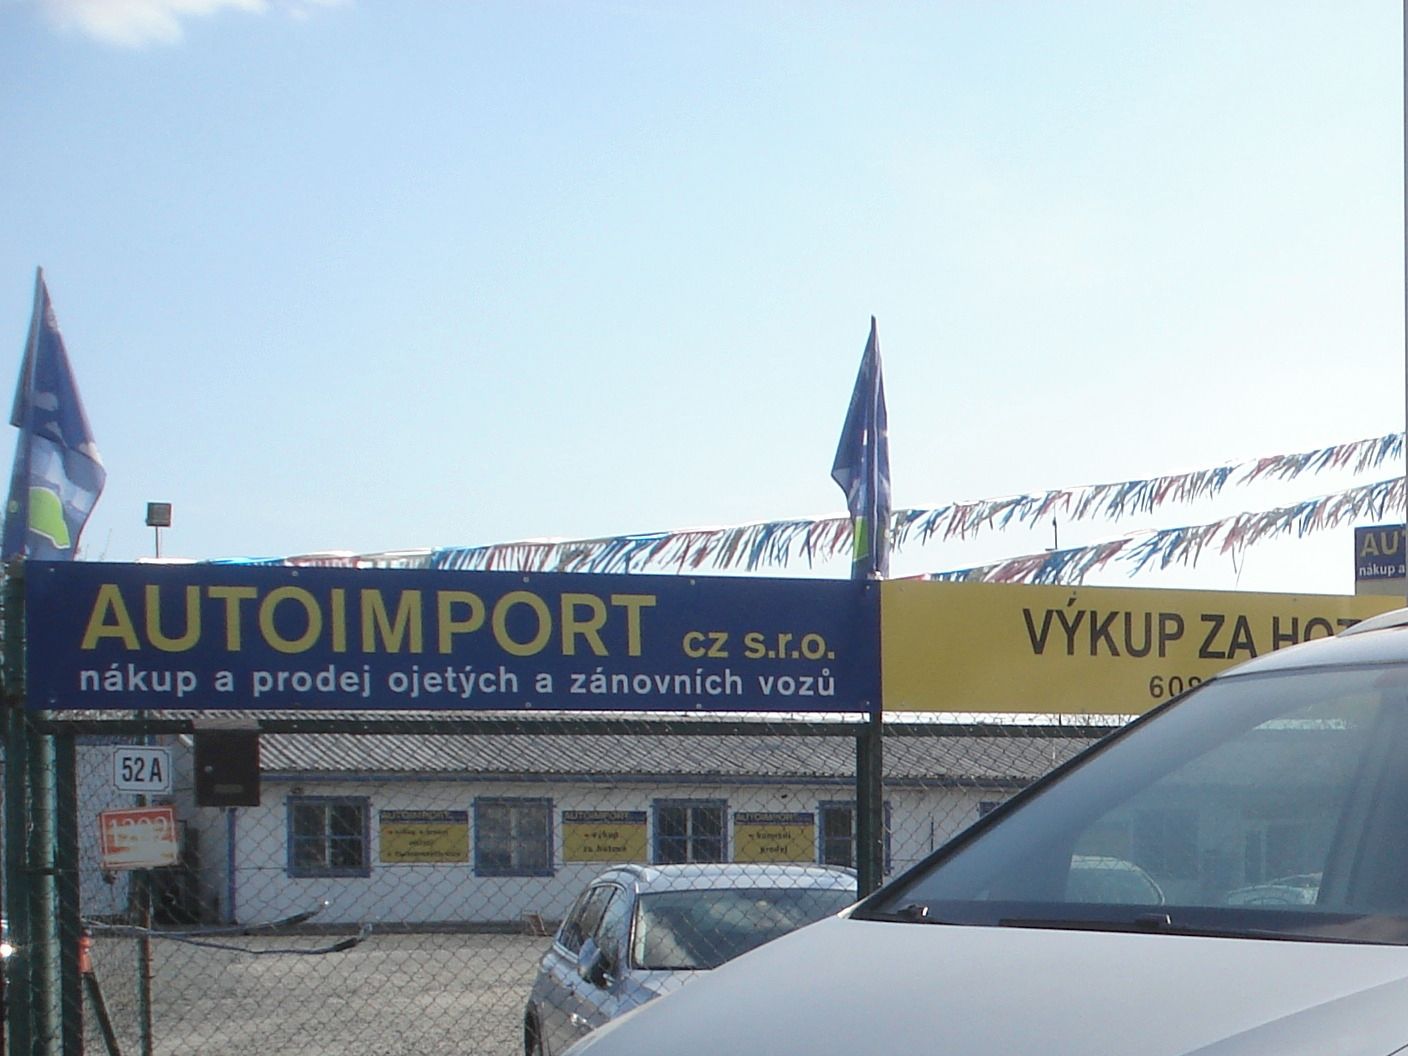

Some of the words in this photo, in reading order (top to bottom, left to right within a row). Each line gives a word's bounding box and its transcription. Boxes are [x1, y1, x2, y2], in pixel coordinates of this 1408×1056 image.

[80, 583, 657, 657] AUTOIMPORT
[682, 631, 729, 659] cz
[744, 632, 836, 661] s.r.o.
[1023, 597, 1186, 658] VÝKUP
[1198, 613, 1258, 659] ZA
[80, 663, 198, 698] nákup
[215, 669, 235, 692] a
[253, 664, 371, 698] prodej
[388, 664, 519, 699] ojetých
[535, 672, 554, 694] a
[570, 666, 743, 697] zánovních
[759, 668, 836, 697] vozů
